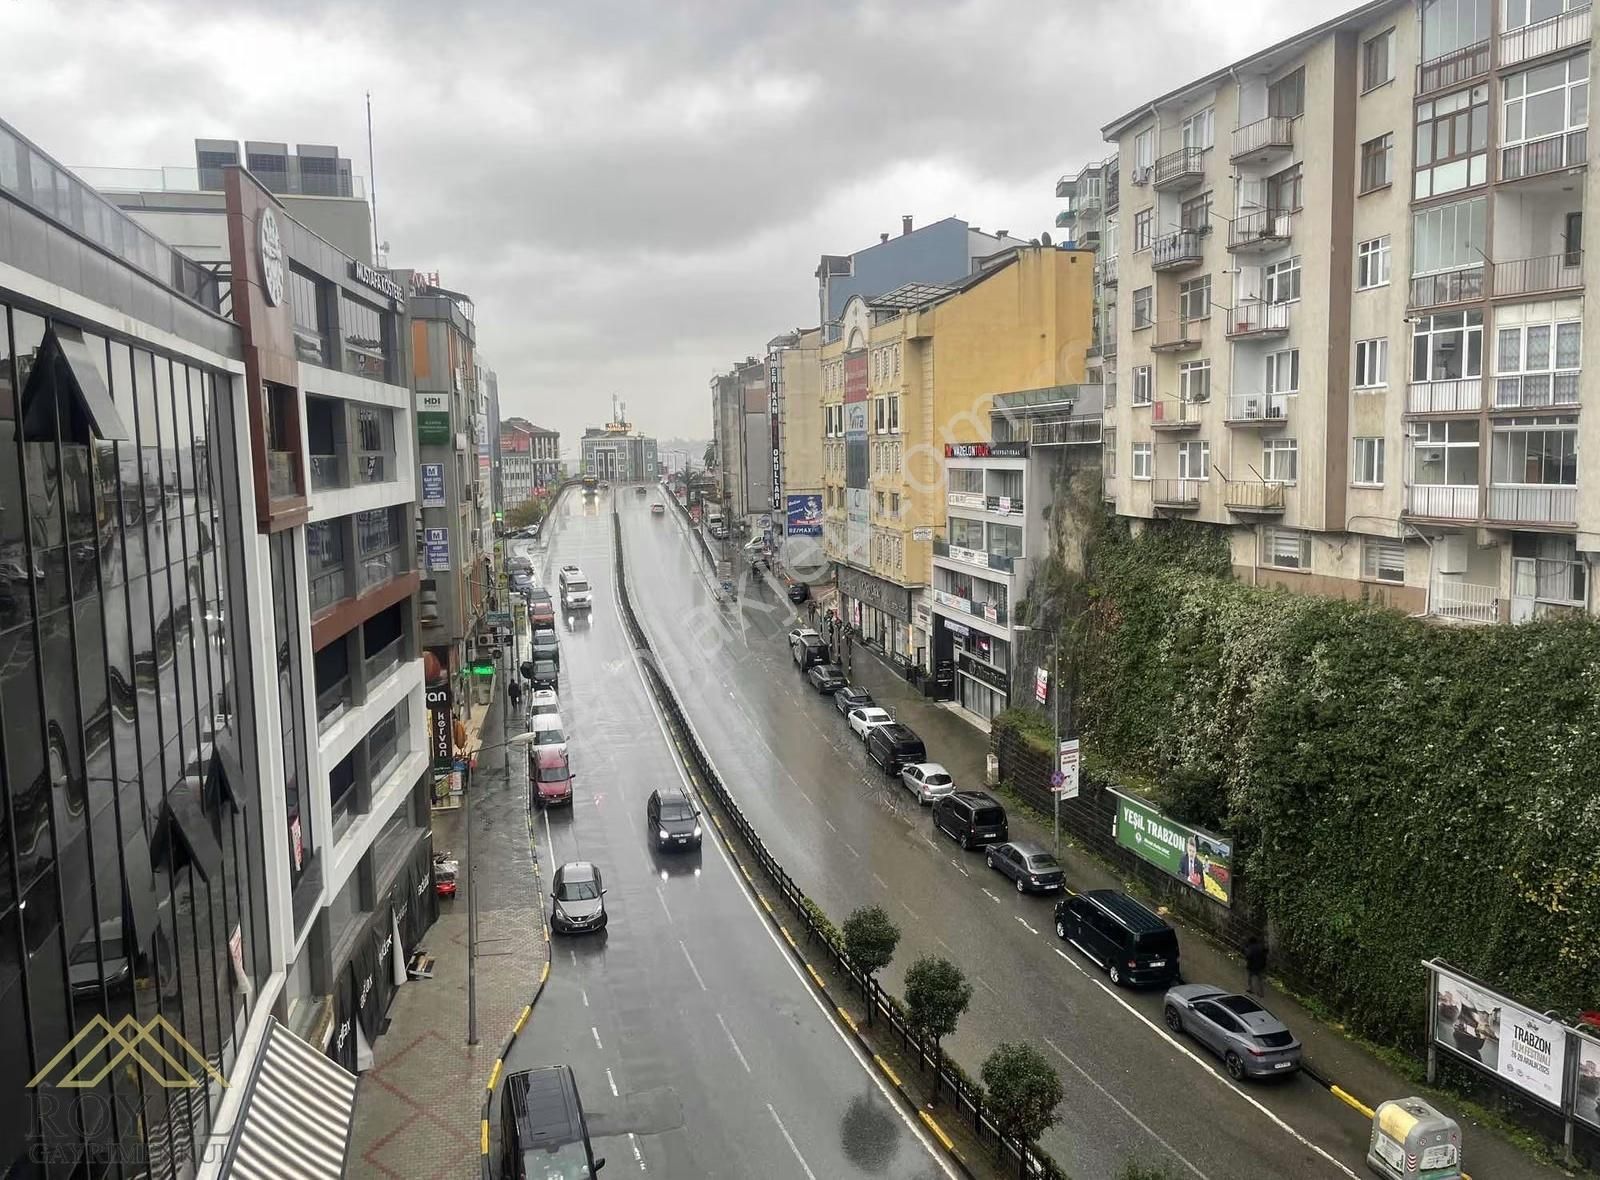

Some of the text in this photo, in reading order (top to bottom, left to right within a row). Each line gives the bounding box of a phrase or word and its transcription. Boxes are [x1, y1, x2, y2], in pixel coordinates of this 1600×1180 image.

[424, 397, 441, 405] HDI
[437, 711, 447, 757] kervan
[1147, 819, 1186, 851] TRABZON
[1513, 1025, 1551, 1056] TRABZON
